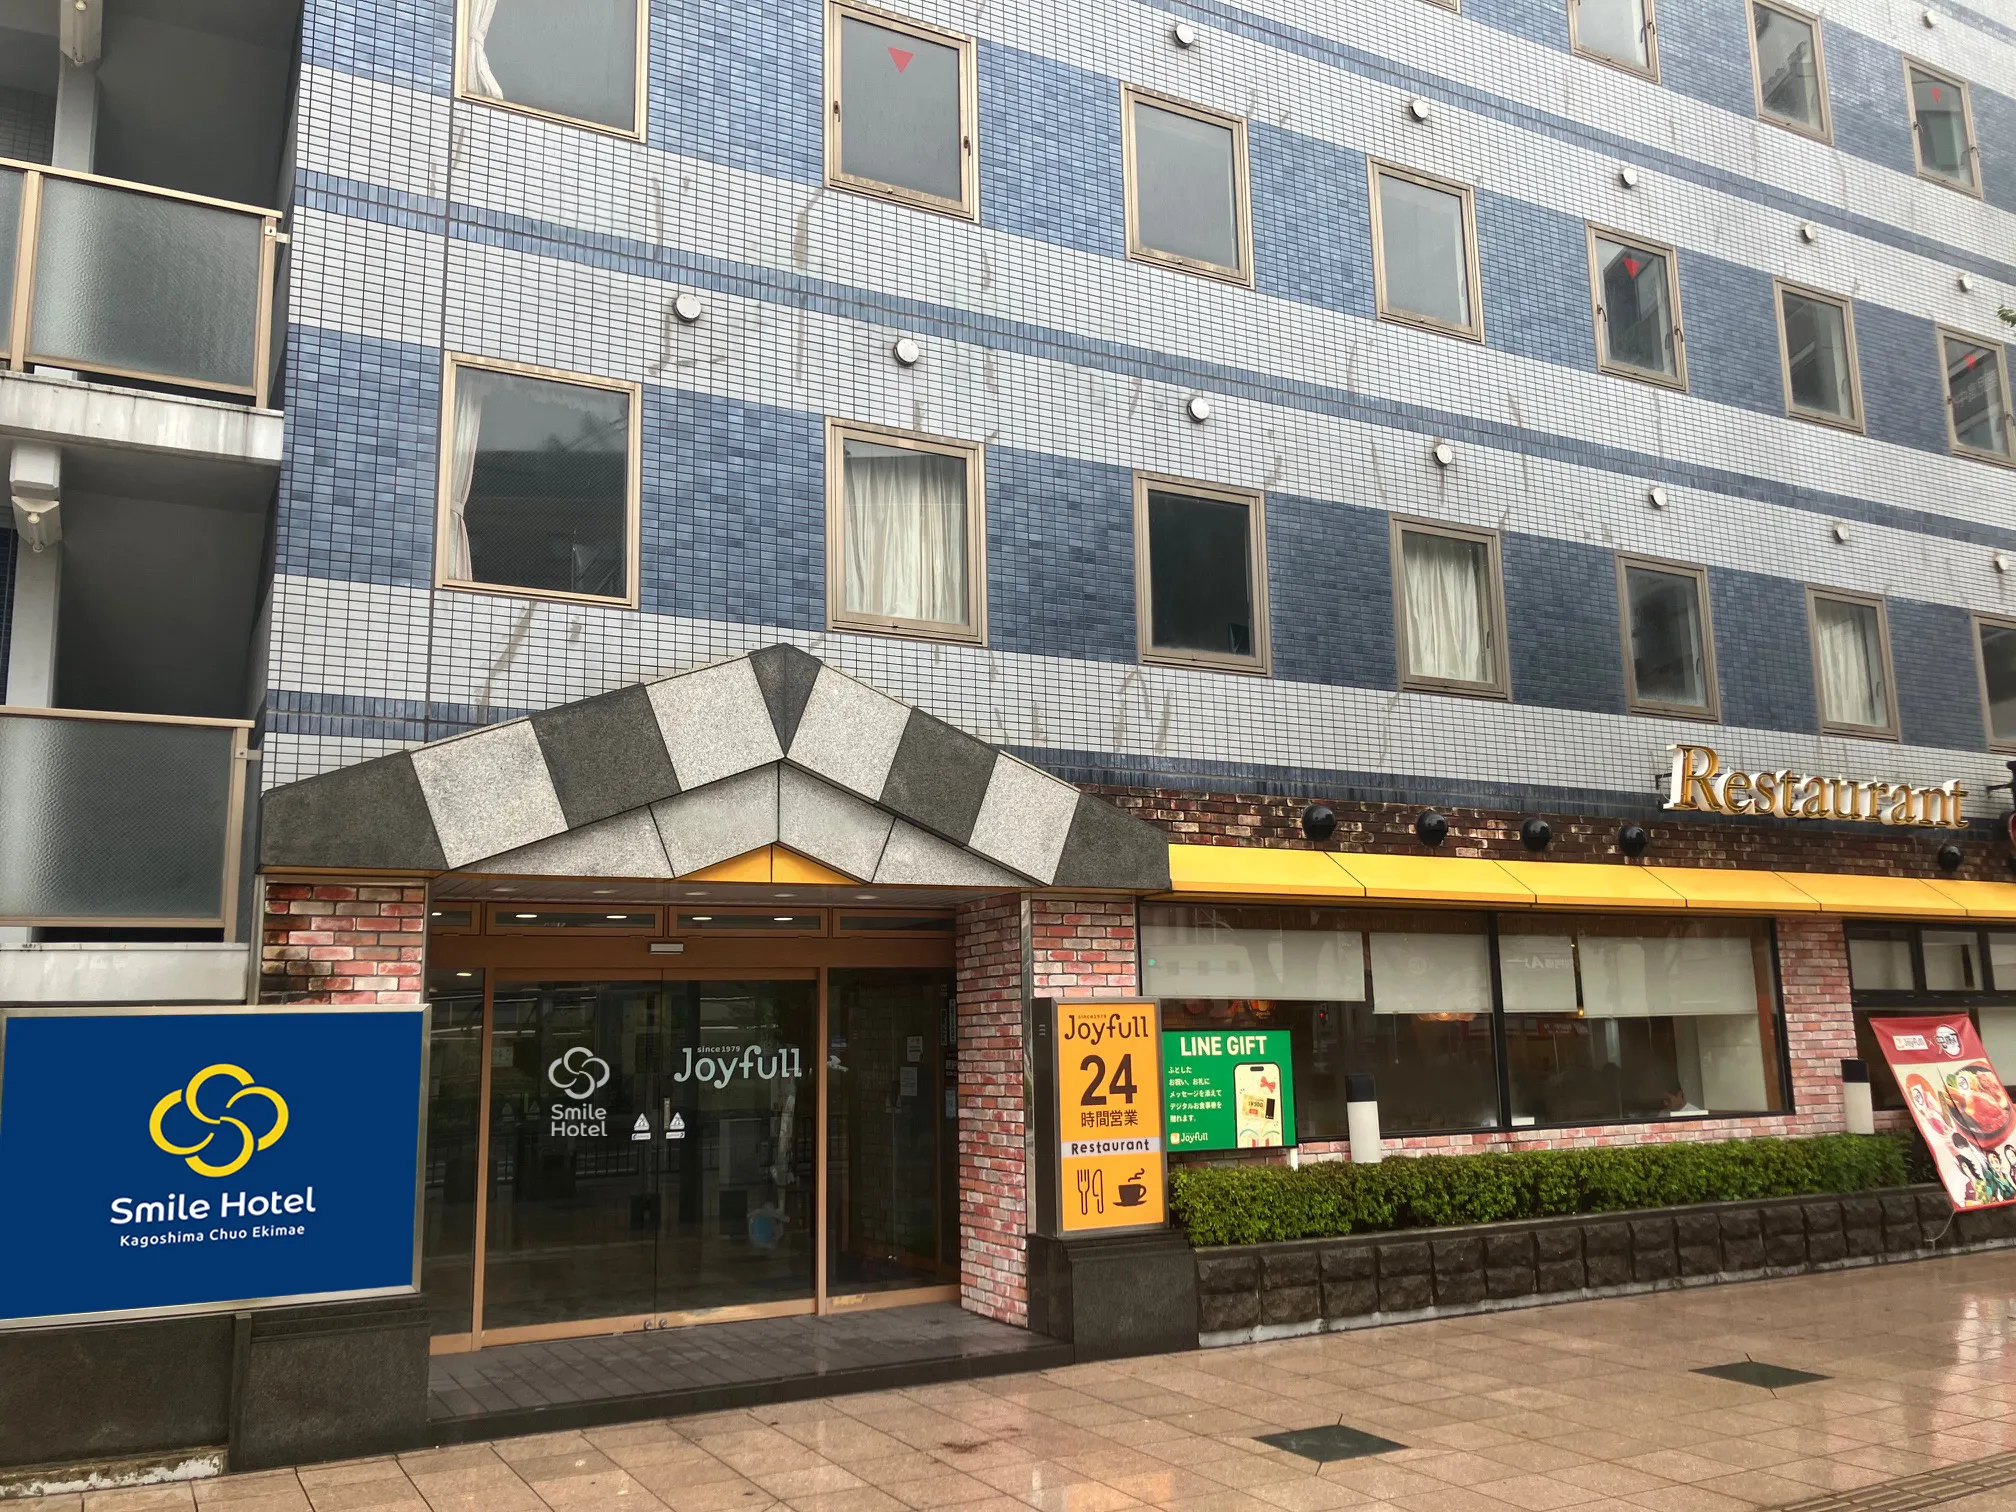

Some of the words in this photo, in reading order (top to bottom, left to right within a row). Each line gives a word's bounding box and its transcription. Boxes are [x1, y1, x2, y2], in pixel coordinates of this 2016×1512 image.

[1663, 744, 1970, 829] Restaurant
[1064, 1013, 1149, 1045] Joyfull
[1180, 1036, 1222, 1056] LINE
[1227, 1035, 1268, 1055] GIFT
[673, 1044, 803, 1089] Joyfull
[1168, 1066, 1192, 1074] ふとした
[1080, 1053, 1138, 1106] 24
[1169, 1089, 1223, 1099] メッセージを添えて
[551, 1103, 607, 1120] Smile
[1080, 1109, 1139, 1128] 時間営業
[551, 1121, 608, 1137] Hotel
[1180, 1132, 1209, 1144] Joyfull
[1071, 1138, 1150, 1155] Restaurant
[110, 1193, 210, 1225] Smile
[220, 1186, 316, 1218] Hotel
[119, 1230, 204, 1248] Kagoshima
[209, 1226, 248, 1242] Chuo
[252, 1223, 306, 1239] Ekimae
